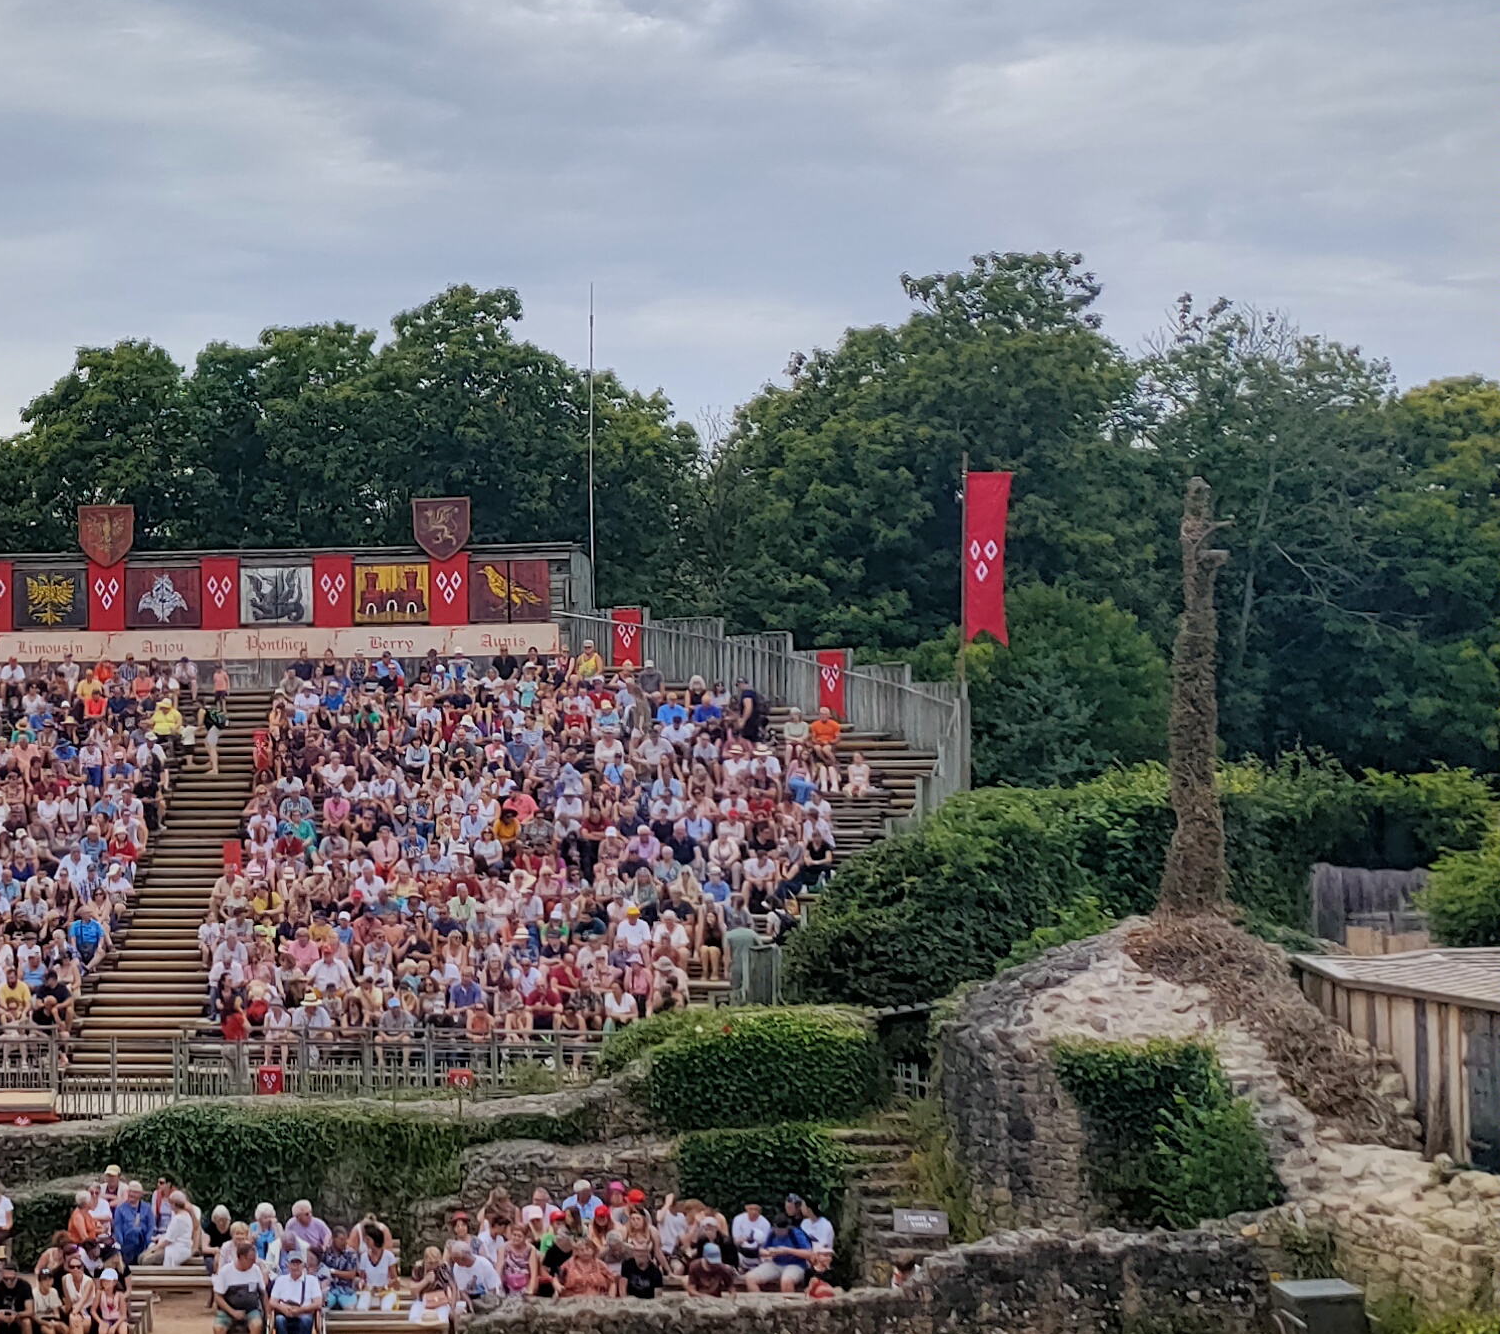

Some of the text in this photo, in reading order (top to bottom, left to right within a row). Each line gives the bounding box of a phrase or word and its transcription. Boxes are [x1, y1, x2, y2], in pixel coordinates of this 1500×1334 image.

[17, 640, 84, 655] Limousin
[141, 639, 184, 658] Anjou
[245, 634, 308, 652] Ponthieu
[368, 635, 415, 653] Berry
[480, 633, 526, 648] Aunis
